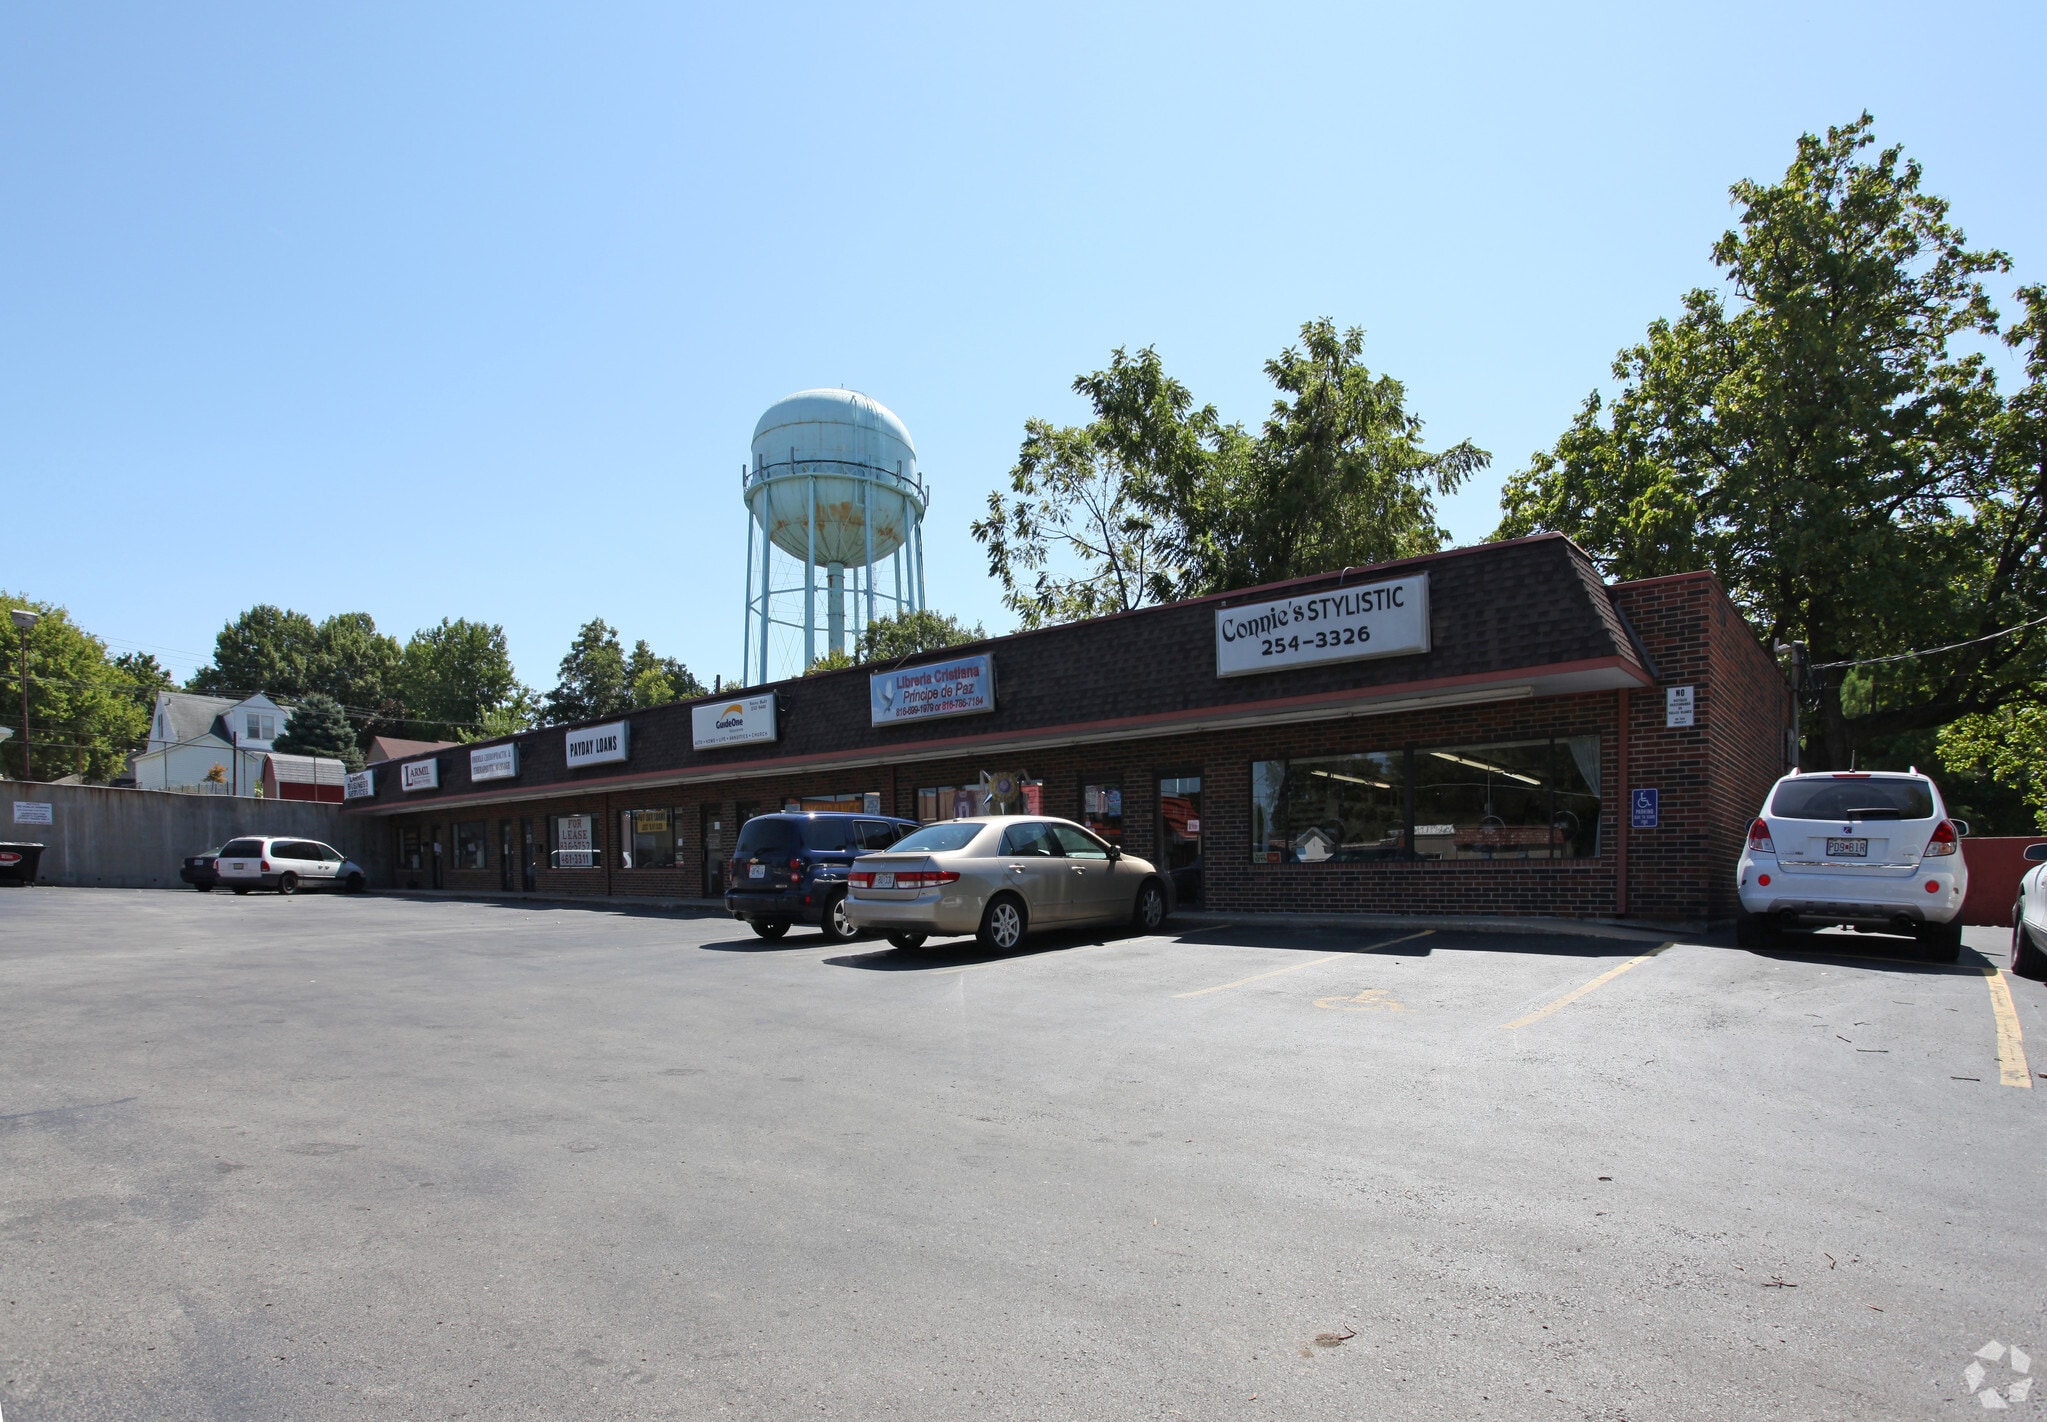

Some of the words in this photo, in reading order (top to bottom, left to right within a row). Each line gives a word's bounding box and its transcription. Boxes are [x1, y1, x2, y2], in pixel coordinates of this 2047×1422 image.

[1222, 600, 1304, 642] Connie's
[1307, 586, 1404, 621] STYLISTIC
[1261, 626, 1370, 656] 254-3326
[934, 665, 980, 683] Cristiana
[941, 685, 953, 698] de
[955, 682, 974, 696] Paz
[1675, 689, 1685, 697] NO
[715, 718, 744, 730] GuideOne
[570, 740, 594, 758] PAYDAY
[596, 735, 617, 753] LOANS
[567, 819, 582, 829] FOR
[562, 830, 588, 840] LEASE
